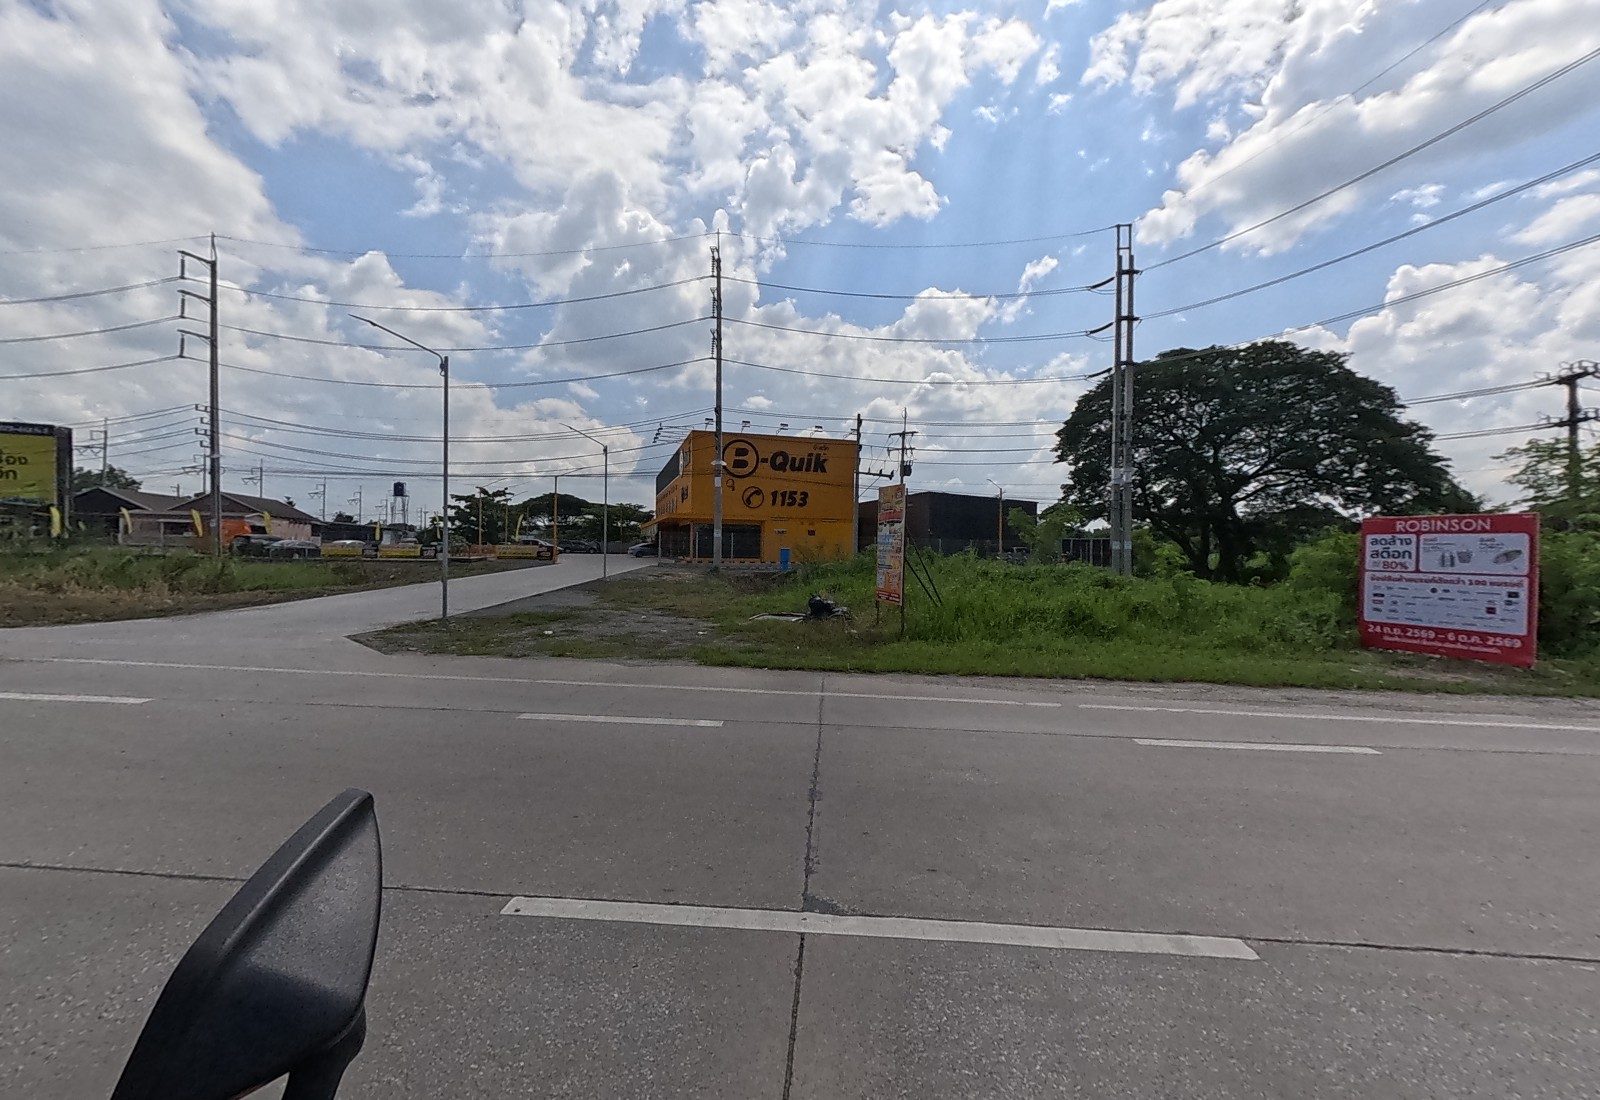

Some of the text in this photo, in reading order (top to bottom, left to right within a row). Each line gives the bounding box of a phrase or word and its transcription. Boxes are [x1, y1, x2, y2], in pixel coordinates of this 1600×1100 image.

[770, 489, 809, 508] 1153
[1396, 518, 1491, 533] ROBINSON
[1382, 560, 1409, 570] 80%
